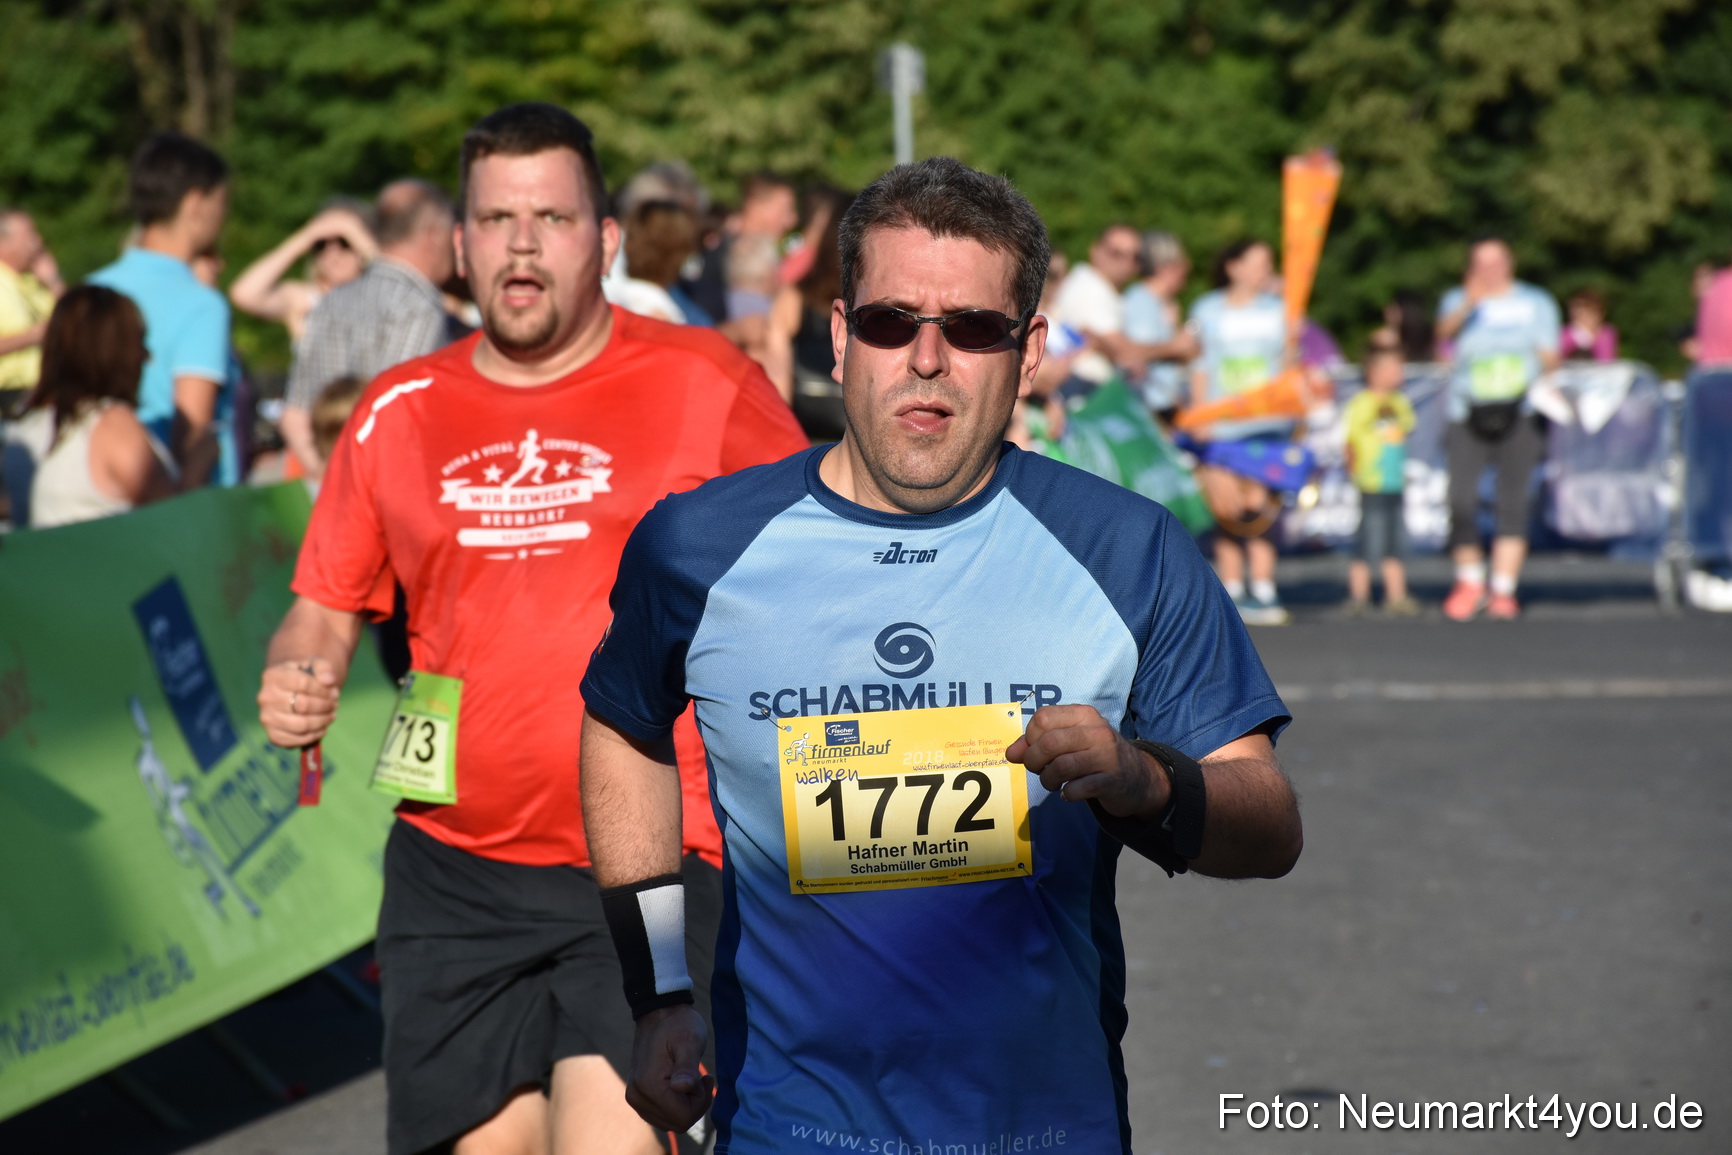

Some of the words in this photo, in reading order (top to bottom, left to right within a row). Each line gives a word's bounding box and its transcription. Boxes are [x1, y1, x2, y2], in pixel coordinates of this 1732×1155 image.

[470, 491, 503, 505] WIR
[509, 485, 579, 506] BEWEGEN
[480, 508, 567, 526] NEUMARKT
[831, 727, 855, 735] Fischer
[811, 739, 892, 759] firmenlauf
[902, 750, 945, 766] 2018
[795, 767, 859, 785] walken
[815, 770, 996, 842] 1772
[847, 843, 908, 860] Hafner
[912, 838, 969, 857] Martin
[850, 860, 926, 875] Schabmüller
[928, 856, 968, 869] GmbH
[791, 1124, 1067, 1155] www.schabmueller.de
